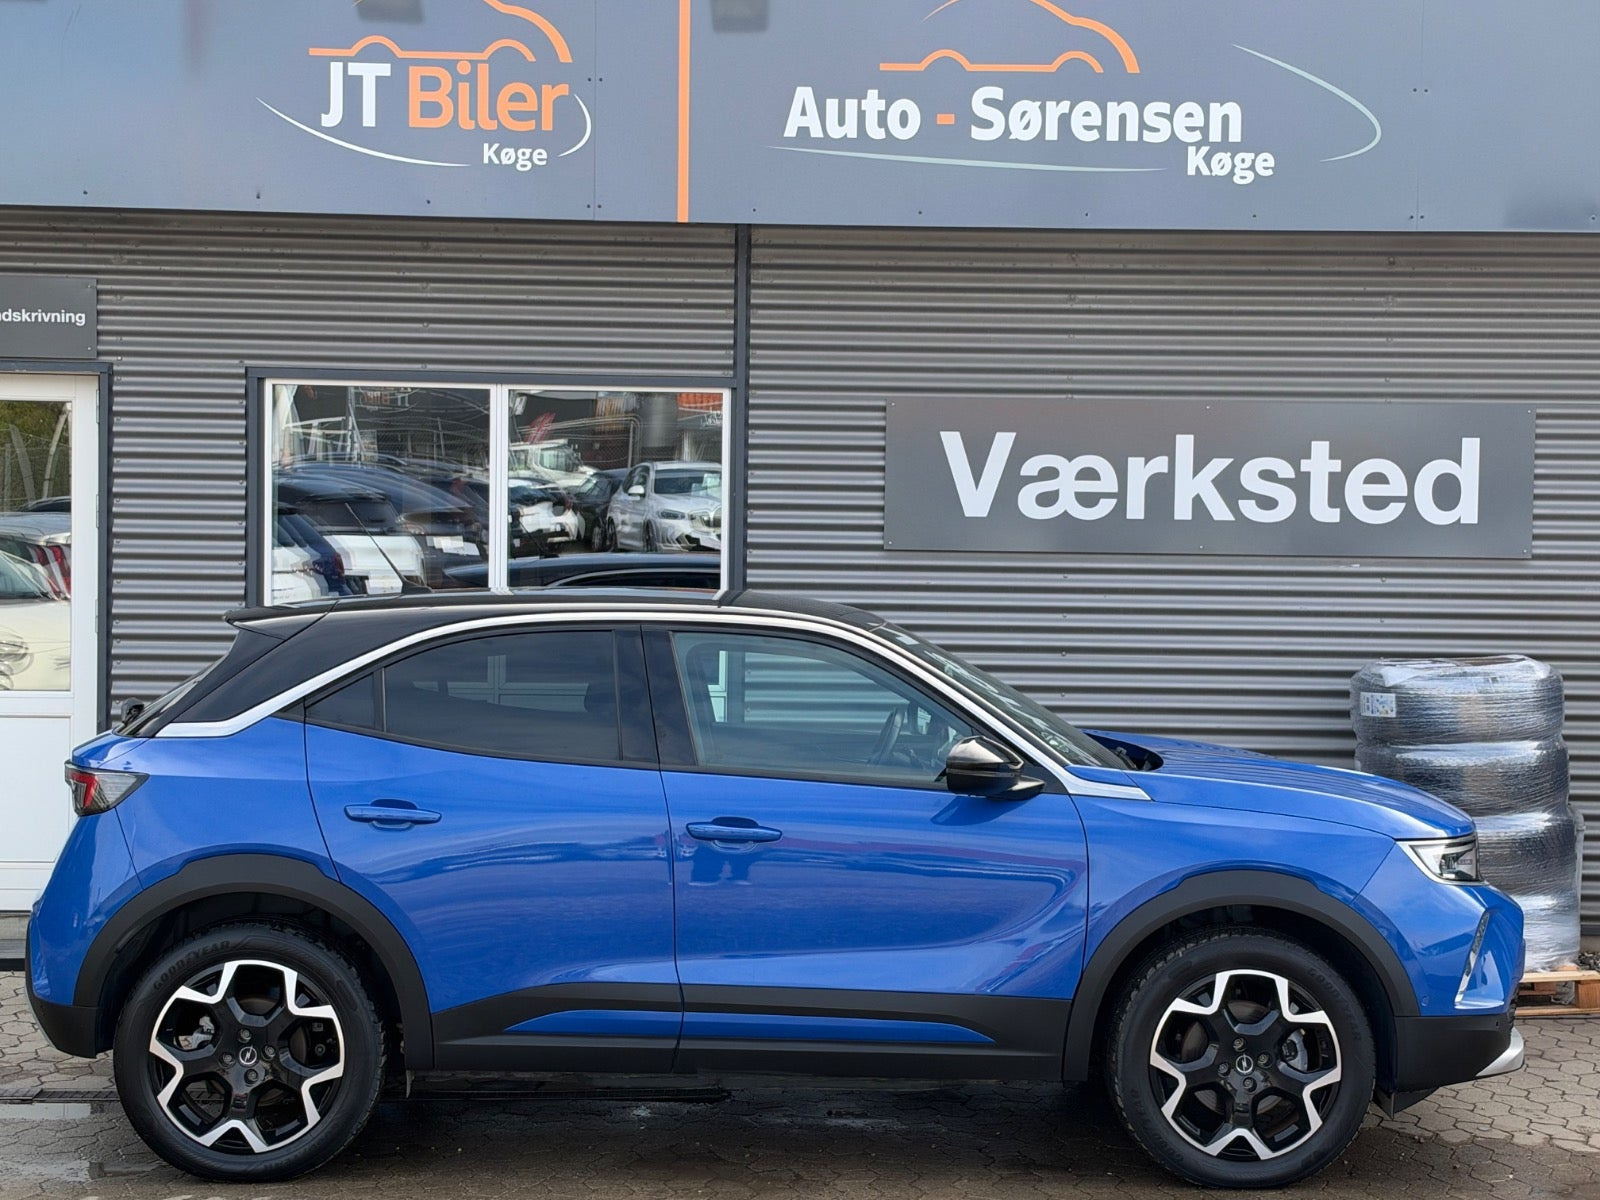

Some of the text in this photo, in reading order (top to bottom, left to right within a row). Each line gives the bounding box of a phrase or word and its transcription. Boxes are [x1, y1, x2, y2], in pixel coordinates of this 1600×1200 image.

[321, 60, 569, 131] JT Biler
[783, 86, 921, 140] Auto
[970, 85, 1242, 143] Sørensen
[483, 142, 548, 171] Køge
[1187, 145, 1275, 185] Køge
[0, 308, 86, 327] dskrivning
[939, 430, 1481, 526] Værksted
